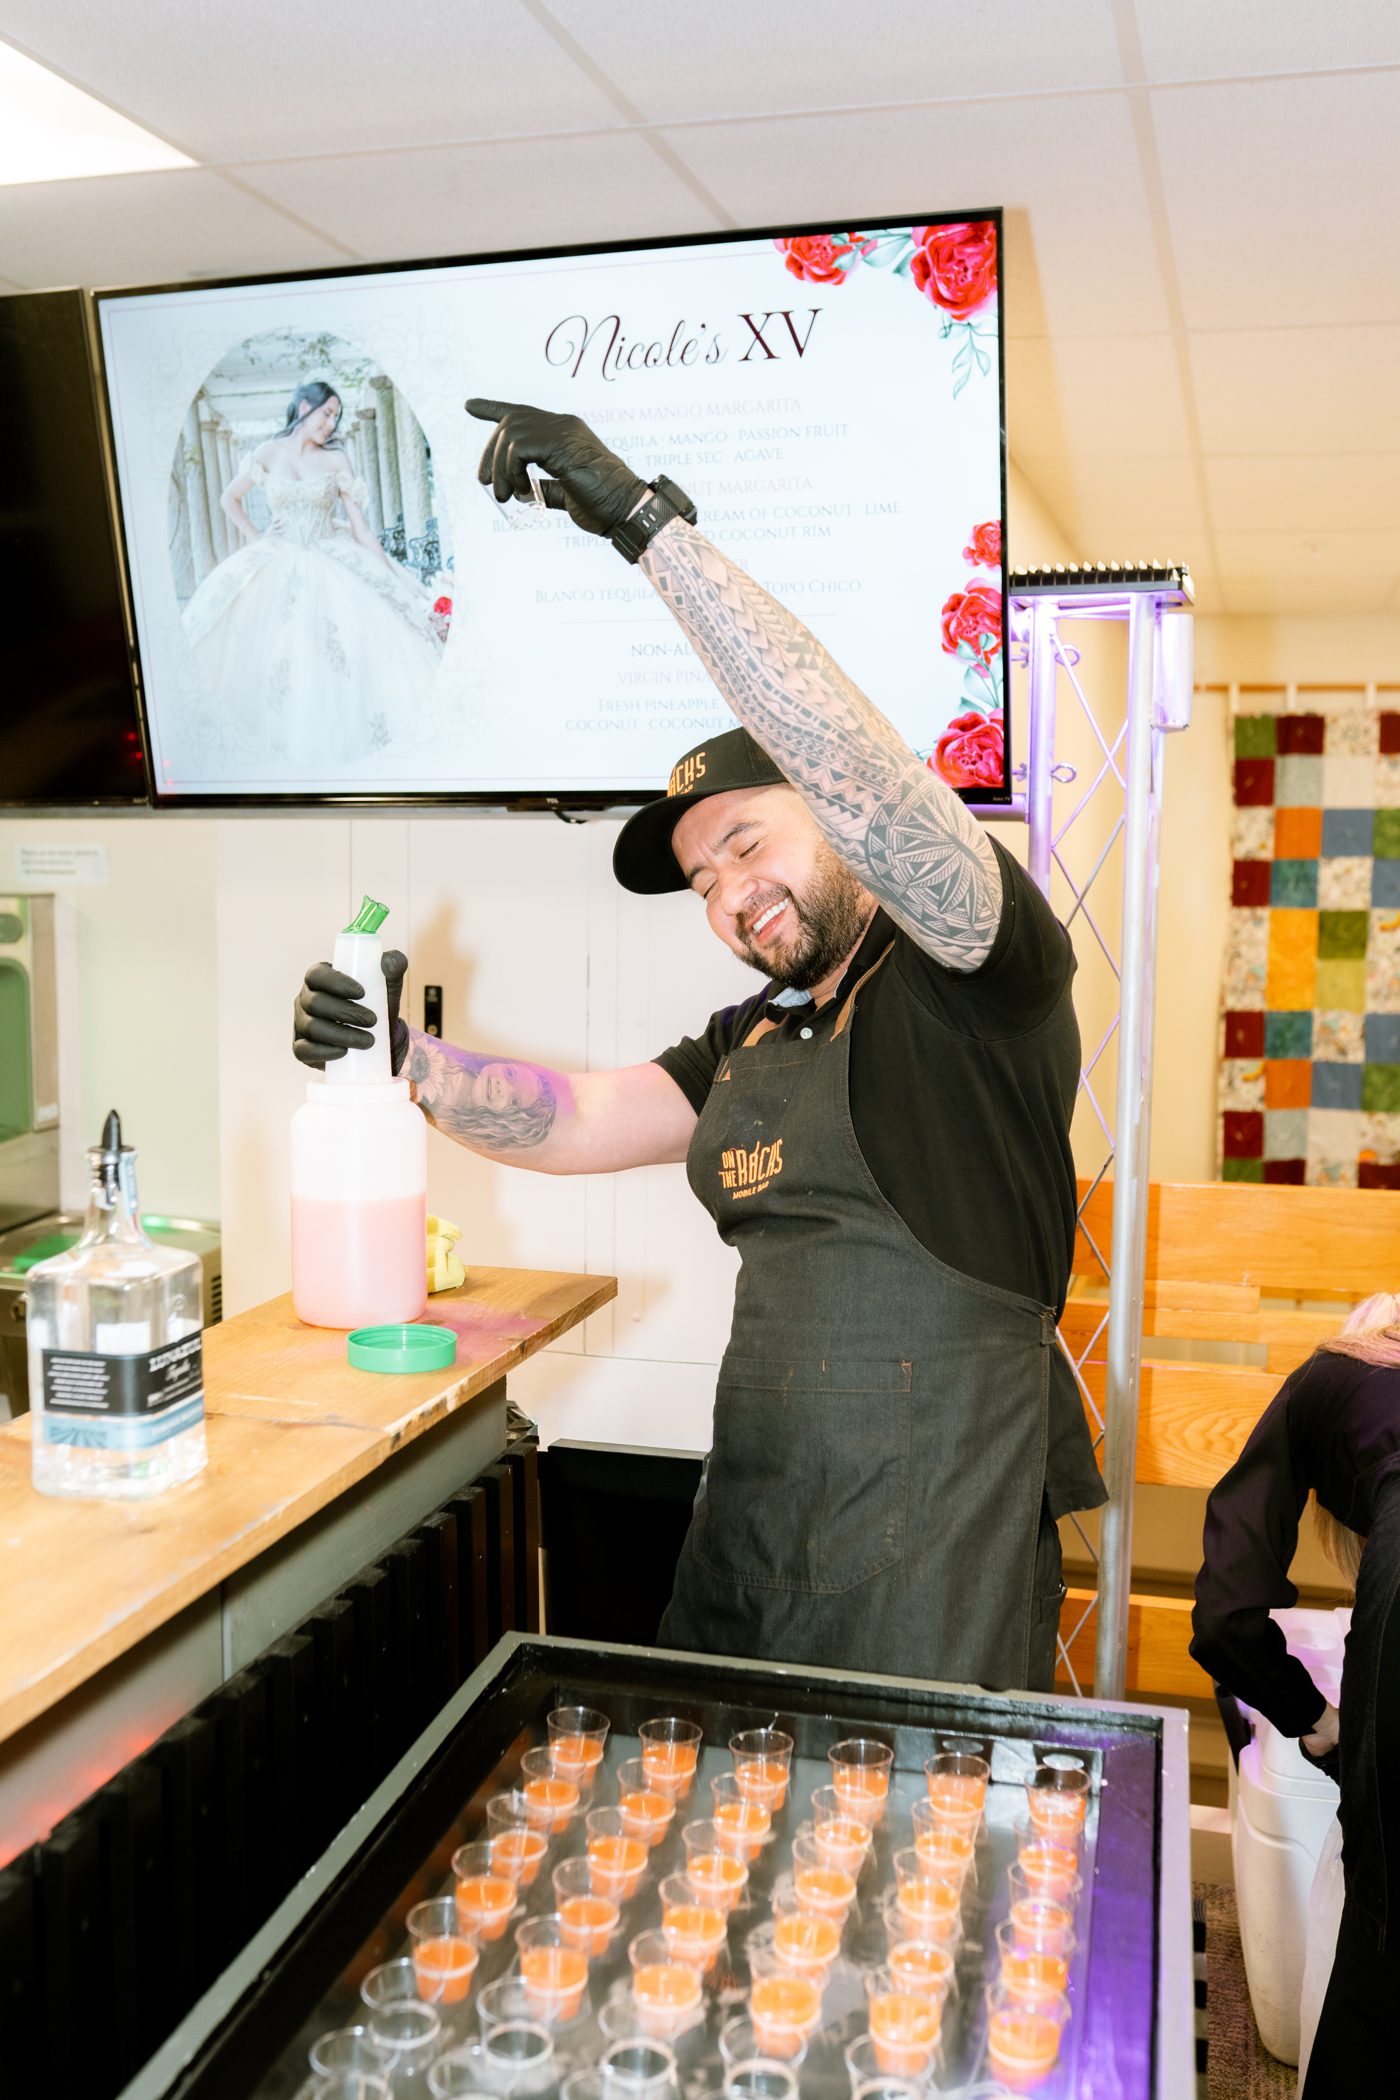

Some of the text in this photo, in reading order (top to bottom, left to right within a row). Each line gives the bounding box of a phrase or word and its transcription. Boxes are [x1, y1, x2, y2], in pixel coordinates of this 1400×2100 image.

[545, 308, 823, 382] Nicole's XV
[638, 403, 703, 421] MANGO
[706, 397, 803, 417] MARGARITA
[668, 431, 729, 446] MANGO
[737, 427, 801, 442] PASSION
[805, 423, 849, 438] FRUIT
[645, 454, 692, 467] TRIPLE
[696, 451, 723, 464] SEC
[733, 447, 785, 462] AGAVE
[718, 476, 814, 495] MARGARITA
[749, 507, 768, 520] OF
[772, 503, 854, 519] COCONUT
[864, 501, 901, 516] LIME
[719, 525, 798, 542] COCONUT
[802, 525, 832, 539] RIM
[536, 589, 594, 603] BLANCO
[809, 579, 862, 594] CHICO
[617, 669, 672, 686] VIRGIN
[599, 697, 721, 712] FRESH PINEAPPLE
[565, 718, 640, 732] COCONUT
[648, 716, 724, 731] COCONUT
[721, 1150, 736, 1169] ON
[718, 1170, 737, 1189] THE
[732, 1186, 757, 1200] MOBILE
